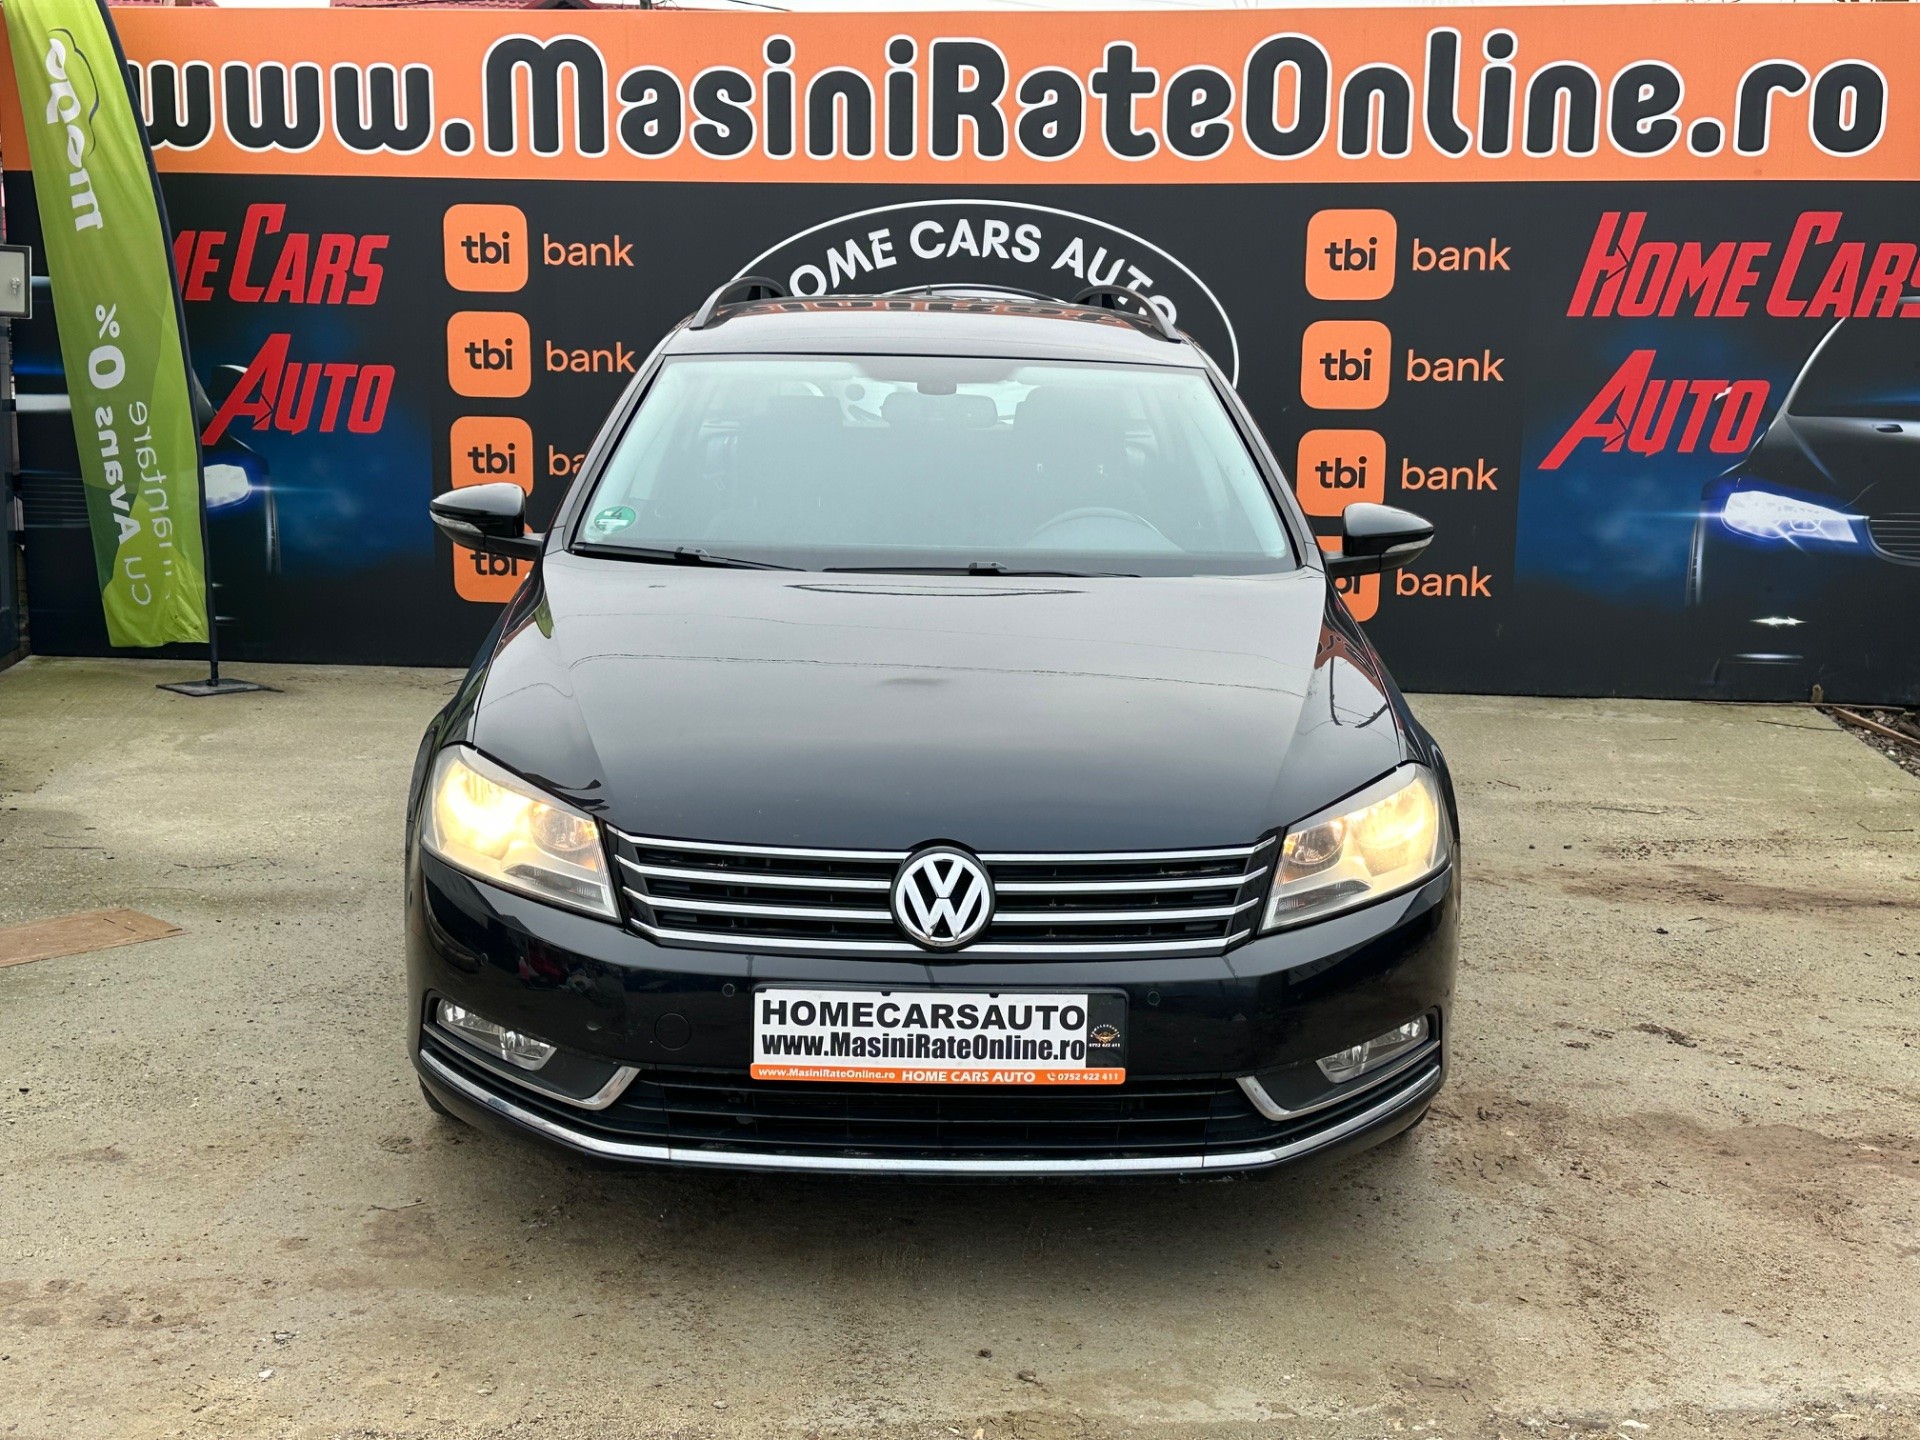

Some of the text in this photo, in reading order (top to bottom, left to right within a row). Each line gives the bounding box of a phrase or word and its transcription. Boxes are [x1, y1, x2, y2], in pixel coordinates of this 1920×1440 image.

[127, 27, 1886, 161] www.MasiniRateOnline.ro
[229, 203, 390, 306] CARS
[461, 231, 634, 267] tbi bank
[789, 228, 897, 297] OME
[910, 218, 1042, 263] CARS
[1324, 237, 1512, 271] tbi bank
[1566, 211, 1772, 317] HOME
[464, 338, 636, 373] tbi bank
[1319, 348, 1505, 382] tbi bank
[201, 333, 395, 446] AUTO
[1537, 349, 1771, 470] AUTO
[467, 443, 516, 474] tbi
[1315, 456, 1498, 491] tbi bank
[1396, 566, 1493, 597] bank
[762, 1000, 1086, 1031] HOMECARSAUTO
[762, 1032, 1086, 1061] www.MasiniRateOnline.ro
[902, 1070, 947, 1082] HOME
[951, 1071, 989, 1083] CARS
[992, 1071, 1036, 1083] AUTO
[1058, 1073, 1081, 1081] 0752
[1082, 1073, 1100, 1081] 422
